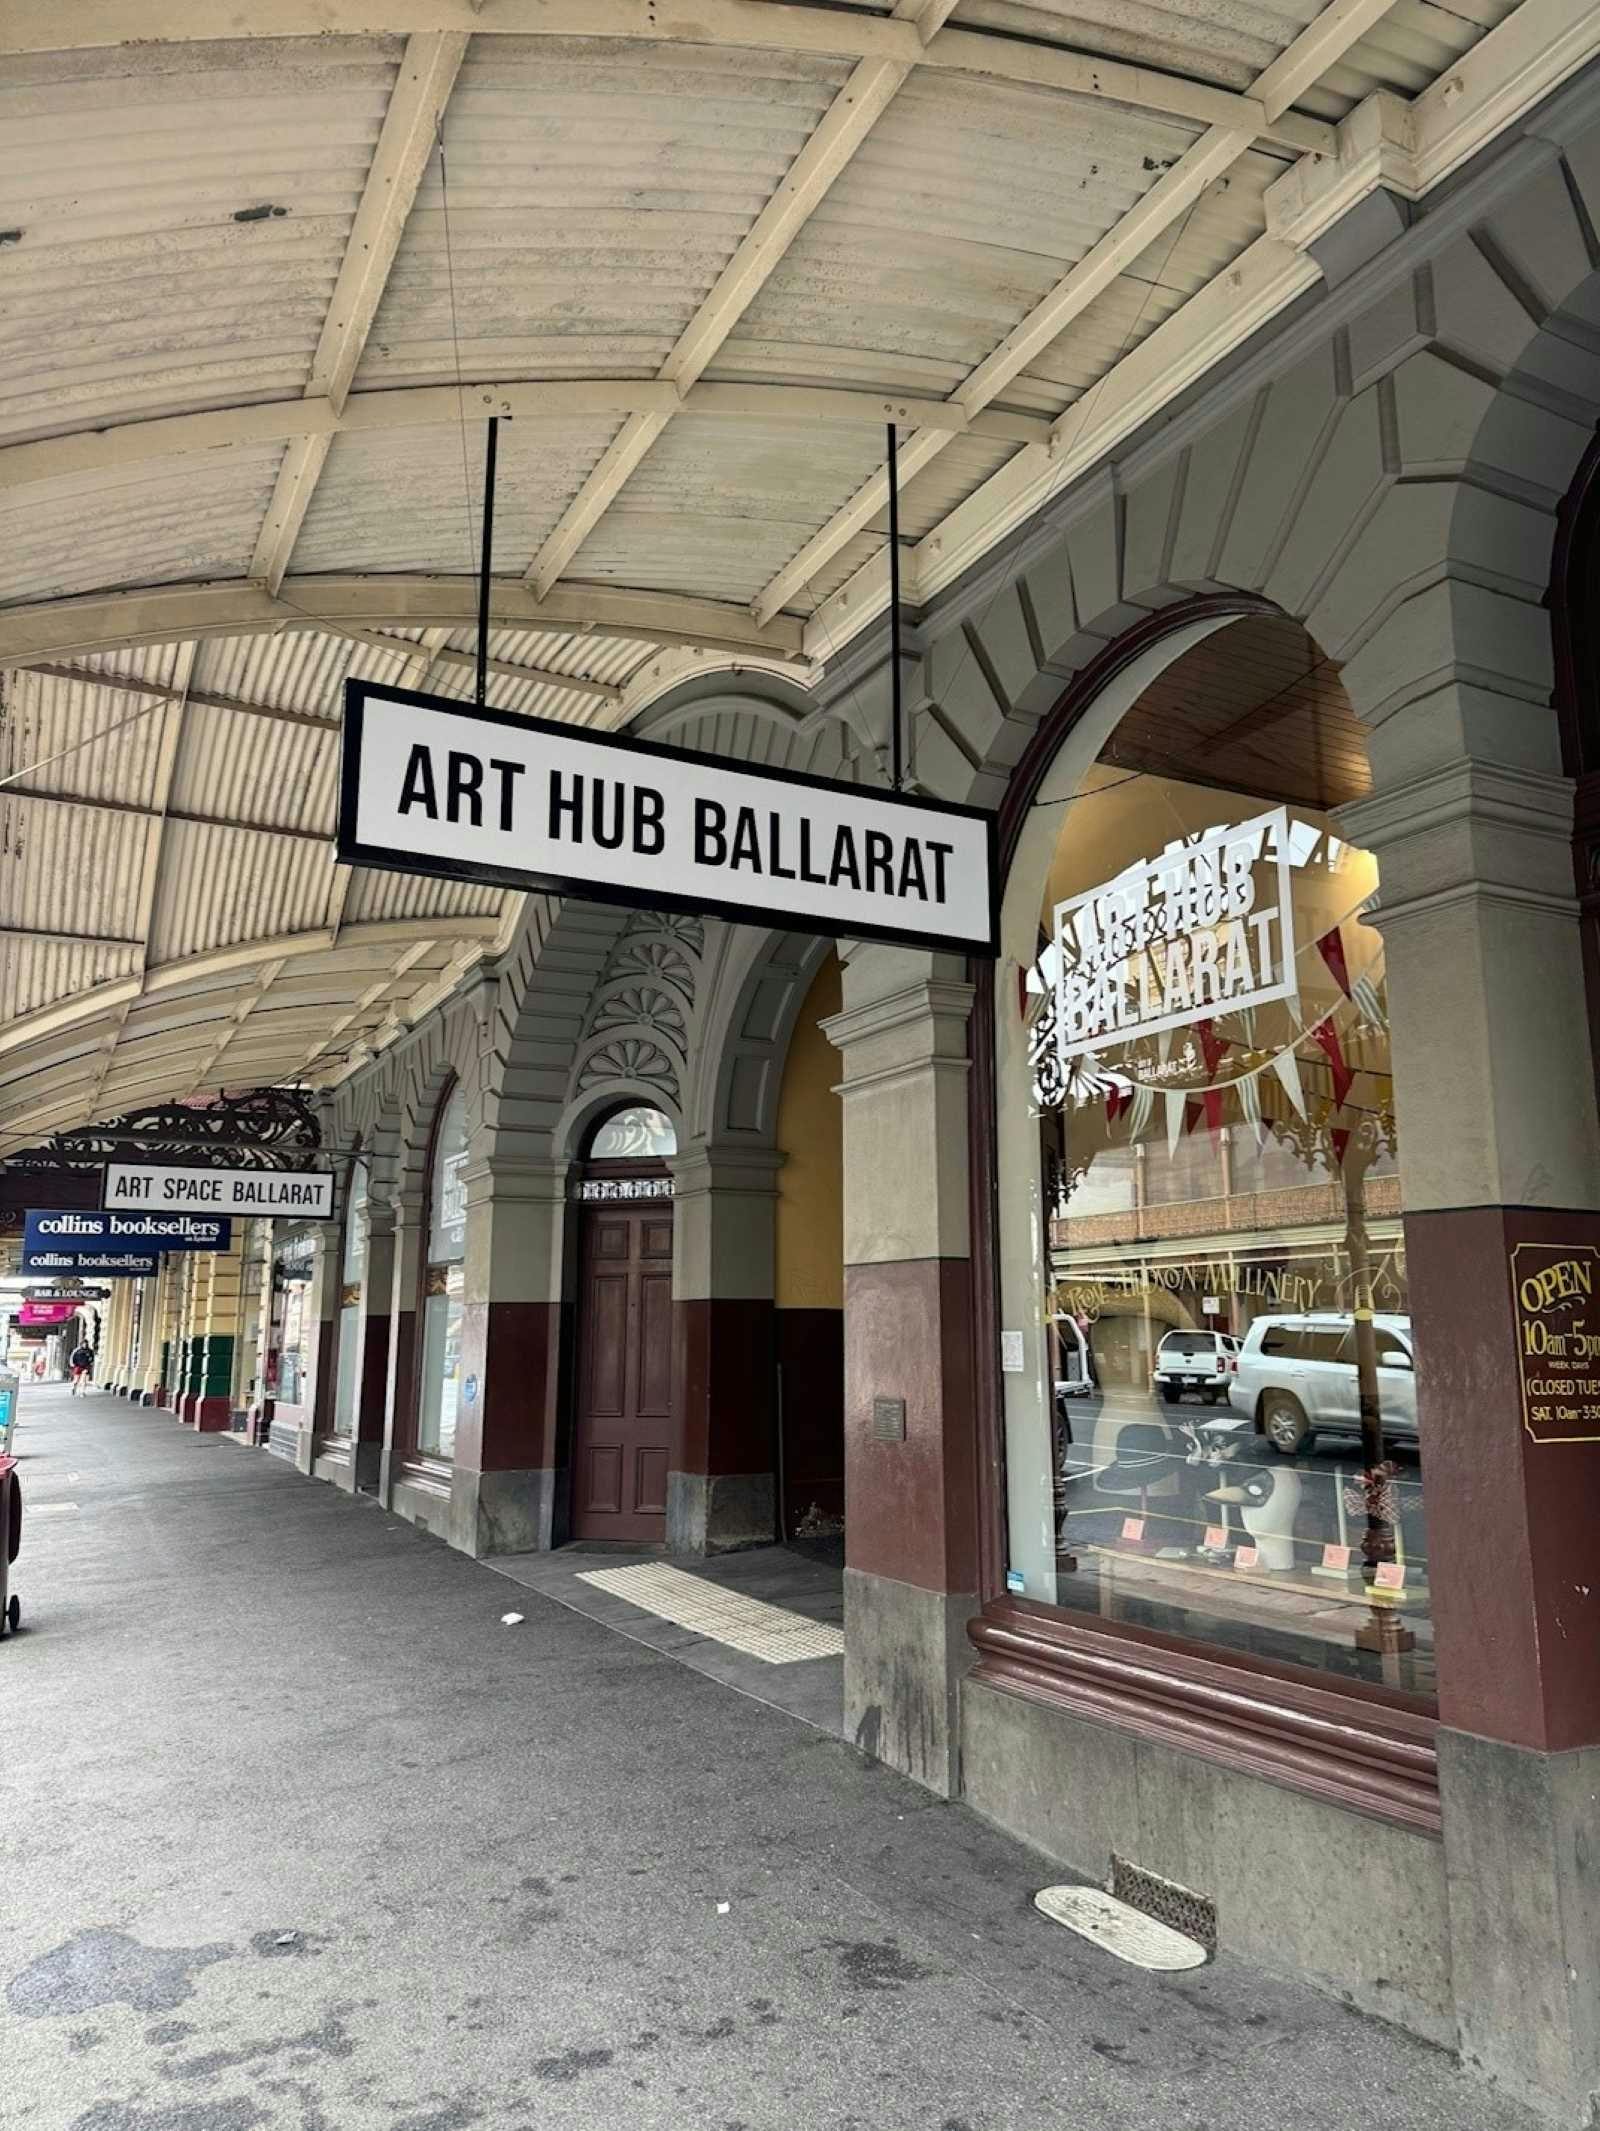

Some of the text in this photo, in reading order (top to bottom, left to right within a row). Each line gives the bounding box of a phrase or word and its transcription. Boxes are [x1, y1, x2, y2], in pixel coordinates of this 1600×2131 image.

[397, 743, 953, 904] ART HUB BALLARAT
[1064, 906, 1280, 1043] BALLARAT
[115, 1175, 325, 1206] ART SPACE BALLARAT
[38, 1215, 103, 1234] collins
[109, 1215, 220, 1236] booksellers
[30, 1253, 153, 1268] collins booksellers
[1520, 1260, 1593, 1312] OPEN
[1526, 1376, 1575, 1397] (CLOSED
